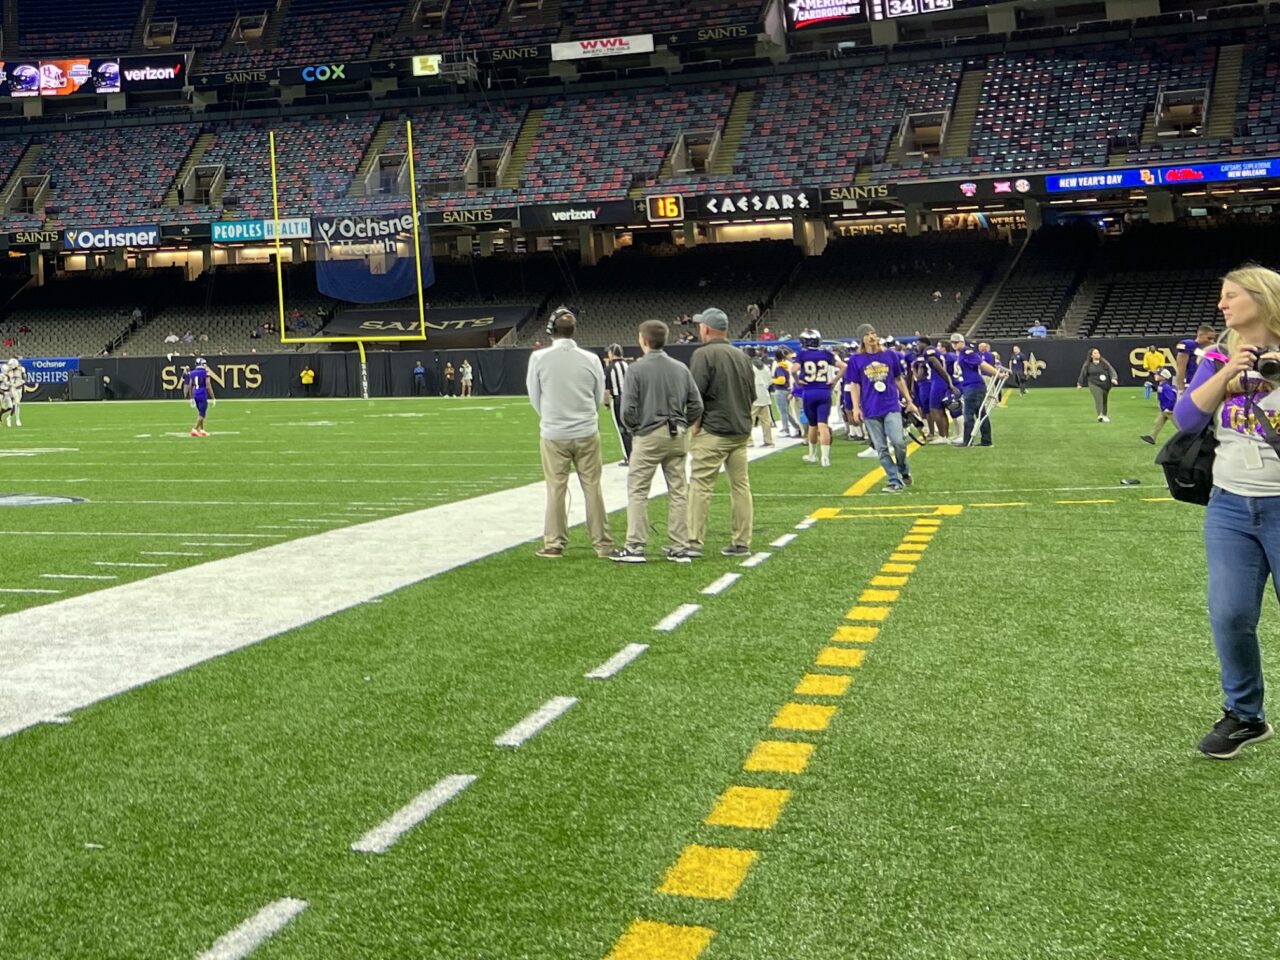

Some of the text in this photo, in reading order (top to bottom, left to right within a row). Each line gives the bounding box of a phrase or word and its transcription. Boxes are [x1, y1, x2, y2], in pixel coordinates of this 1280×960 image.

[698, 25, 748, 41] SAINTS
[579, 38, 630, 49] WWL
[492, 46, 538, 61] SAINTS
[124, 66, 175, 81] verizon
[224, 72, 267, 84] SAINTS
[301, 63, 346, 82] COX
[1059, 178, 1077, 188] NEW
[1077, 176, 1106, 186] YEAR'S
[1106, 174, 1122, 185] DAY
[830, 185, 888, 200] SAINTS
[656, 197, 678, 217] 16
[706, 192, 810, 214] CAESARS
[443, 209, 493, 223] SAINTS
[551, 210, 596, 223] verizon
[214, 223, 262, 239] PEOPLES
[339, 211, 421, 237] Ochsner
[16, 231, 58, 243] SAINTS
[77, 229, 157, 249] Ochsner
[36, 360, 67, 369] Ochsner
[803, 360, 829, 382] 92
[194, 375, 200, 390] 1
